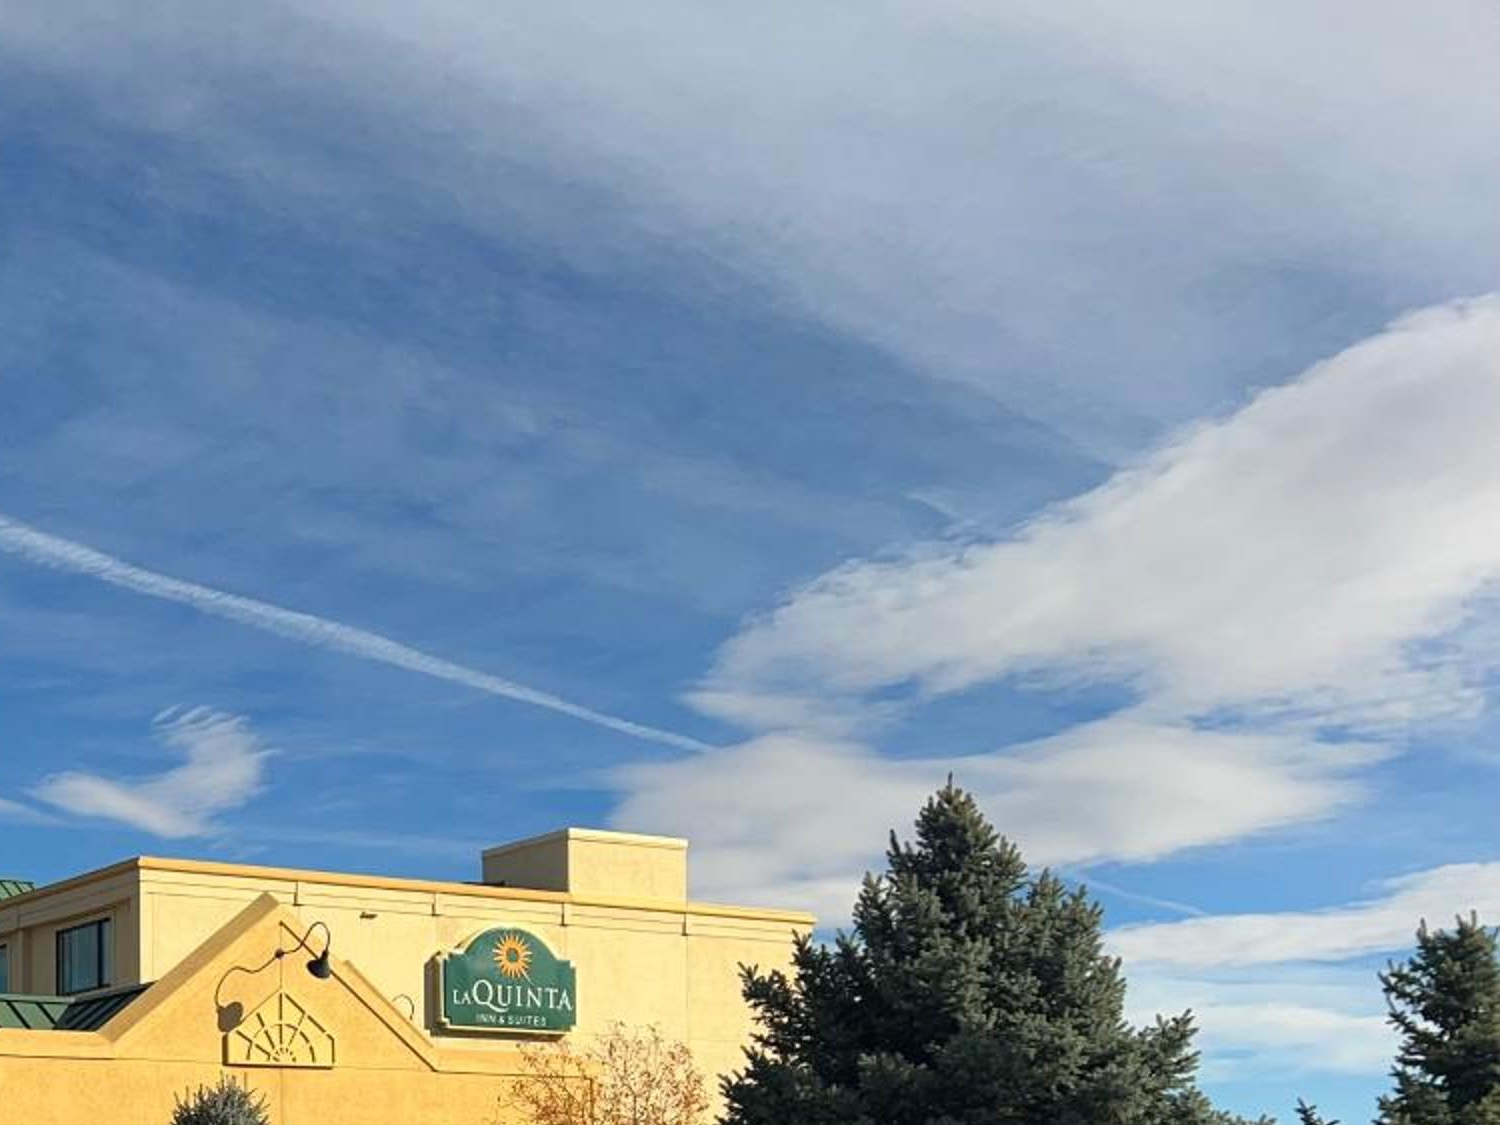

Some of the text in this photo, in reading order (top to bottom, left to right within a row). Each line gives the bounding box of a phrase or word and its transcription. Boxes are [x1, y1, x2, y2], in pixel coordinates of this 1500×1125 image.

[476, 1013, 547, 1026] INN & SUITES
